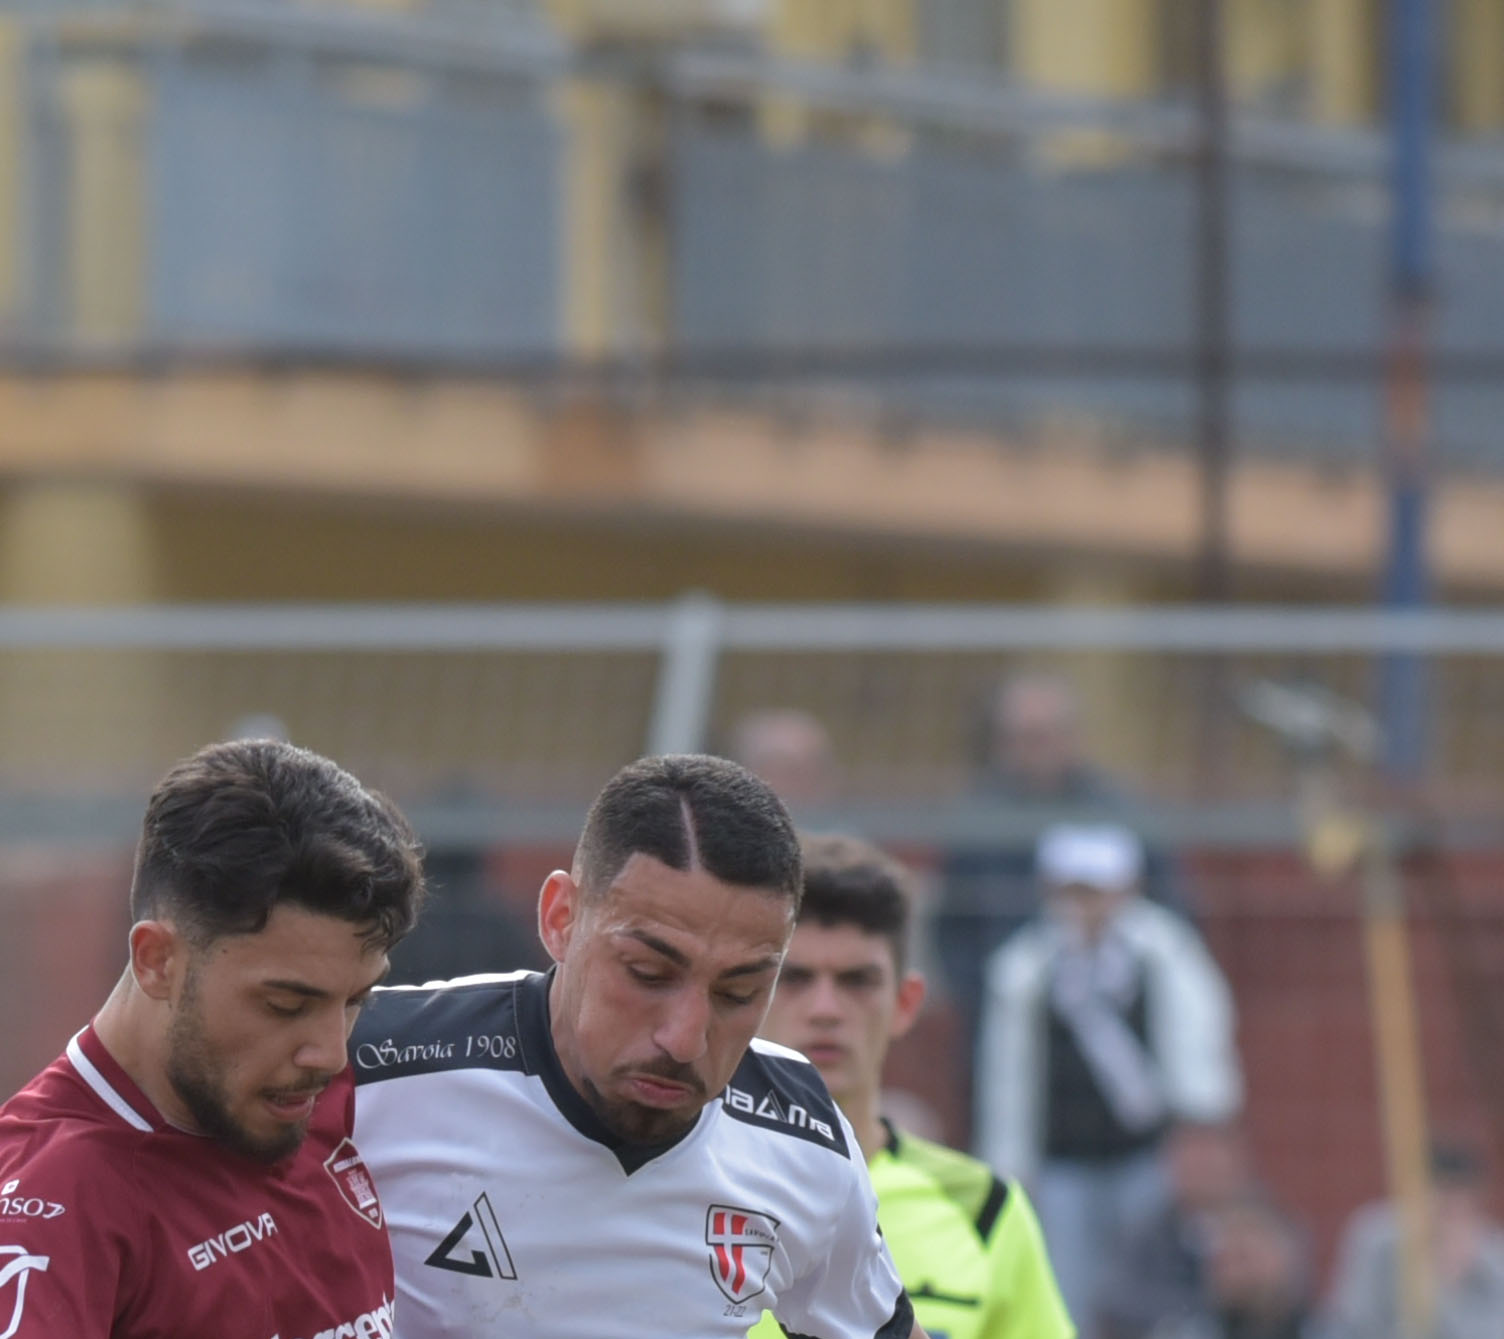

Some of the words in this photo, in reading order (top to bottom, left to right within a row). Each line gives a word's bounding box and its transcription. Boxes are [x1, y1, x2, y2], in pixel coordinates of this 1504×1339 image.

[356, 1038, 456, 1069] Savoia
[465, 1035, 516, 1058] 1908
[187, 1212, 279, 1271] GIVOVA
